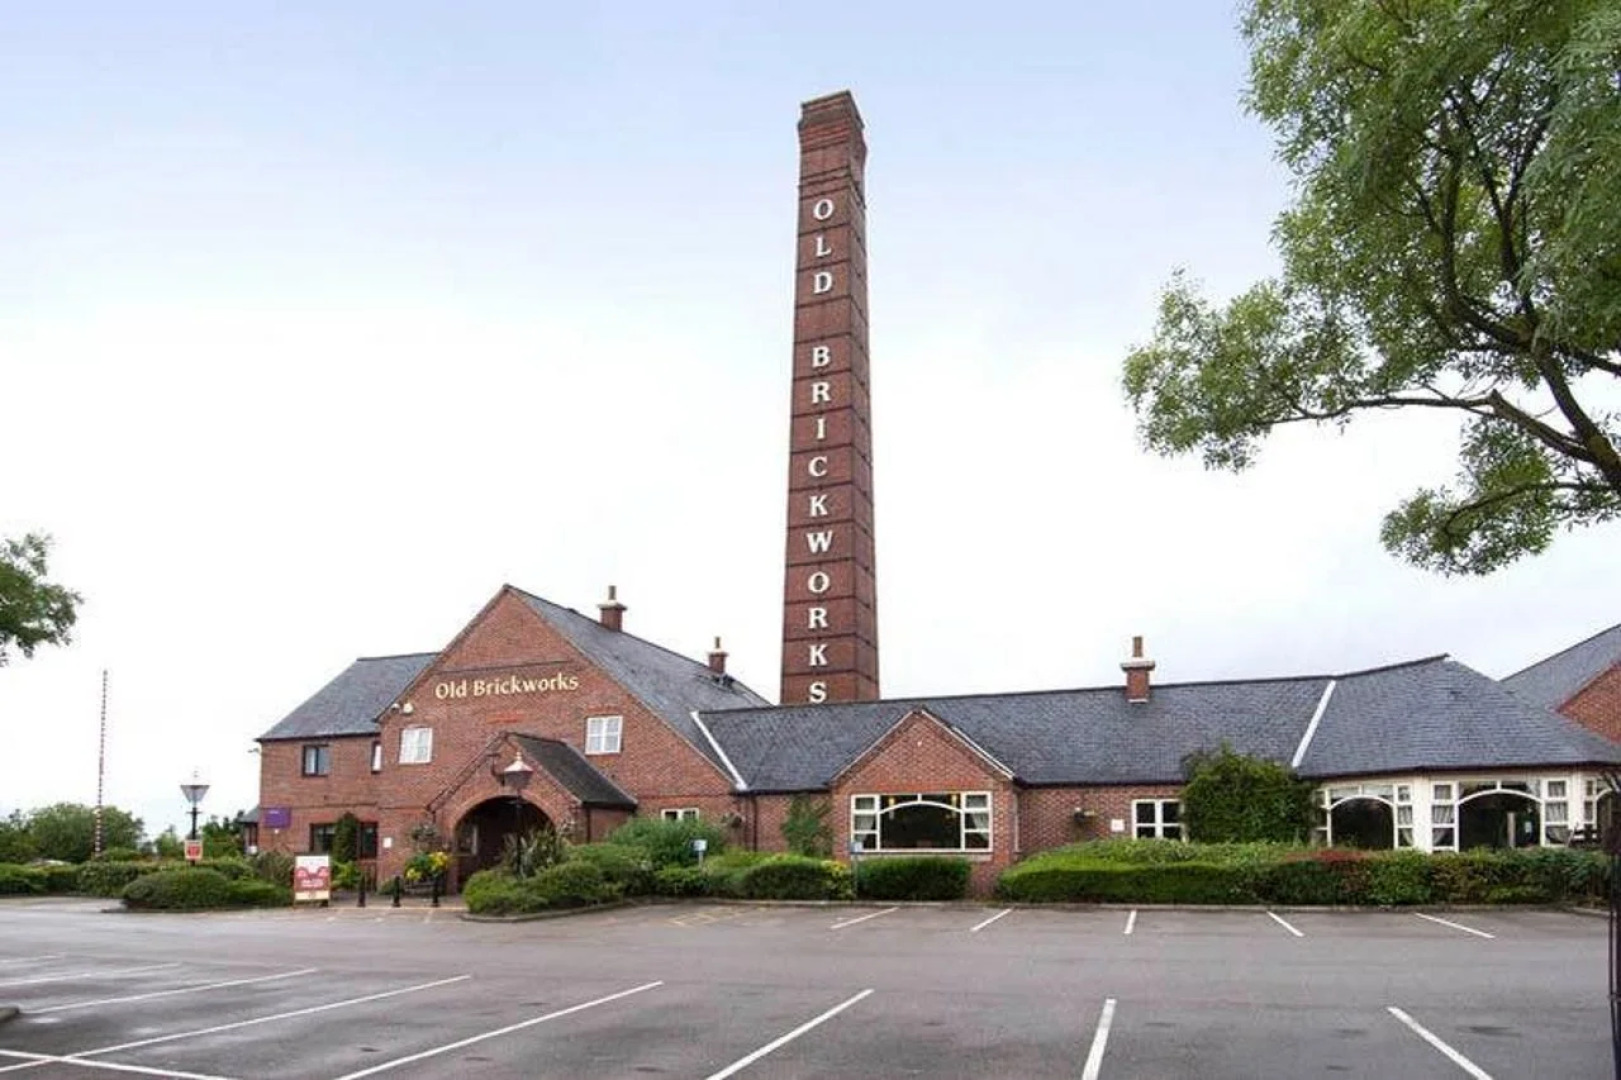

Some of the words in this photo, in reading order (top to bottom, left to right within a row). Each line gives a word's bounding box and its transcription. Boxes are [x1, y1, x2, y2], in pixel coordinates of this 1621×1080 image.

[812, 198, 835, 294] OLD
[806, 345, 834, 704] BRICKWORKS
[434, 678, 467, 700] Old
[473, 671, 580, 697] Brickworks
